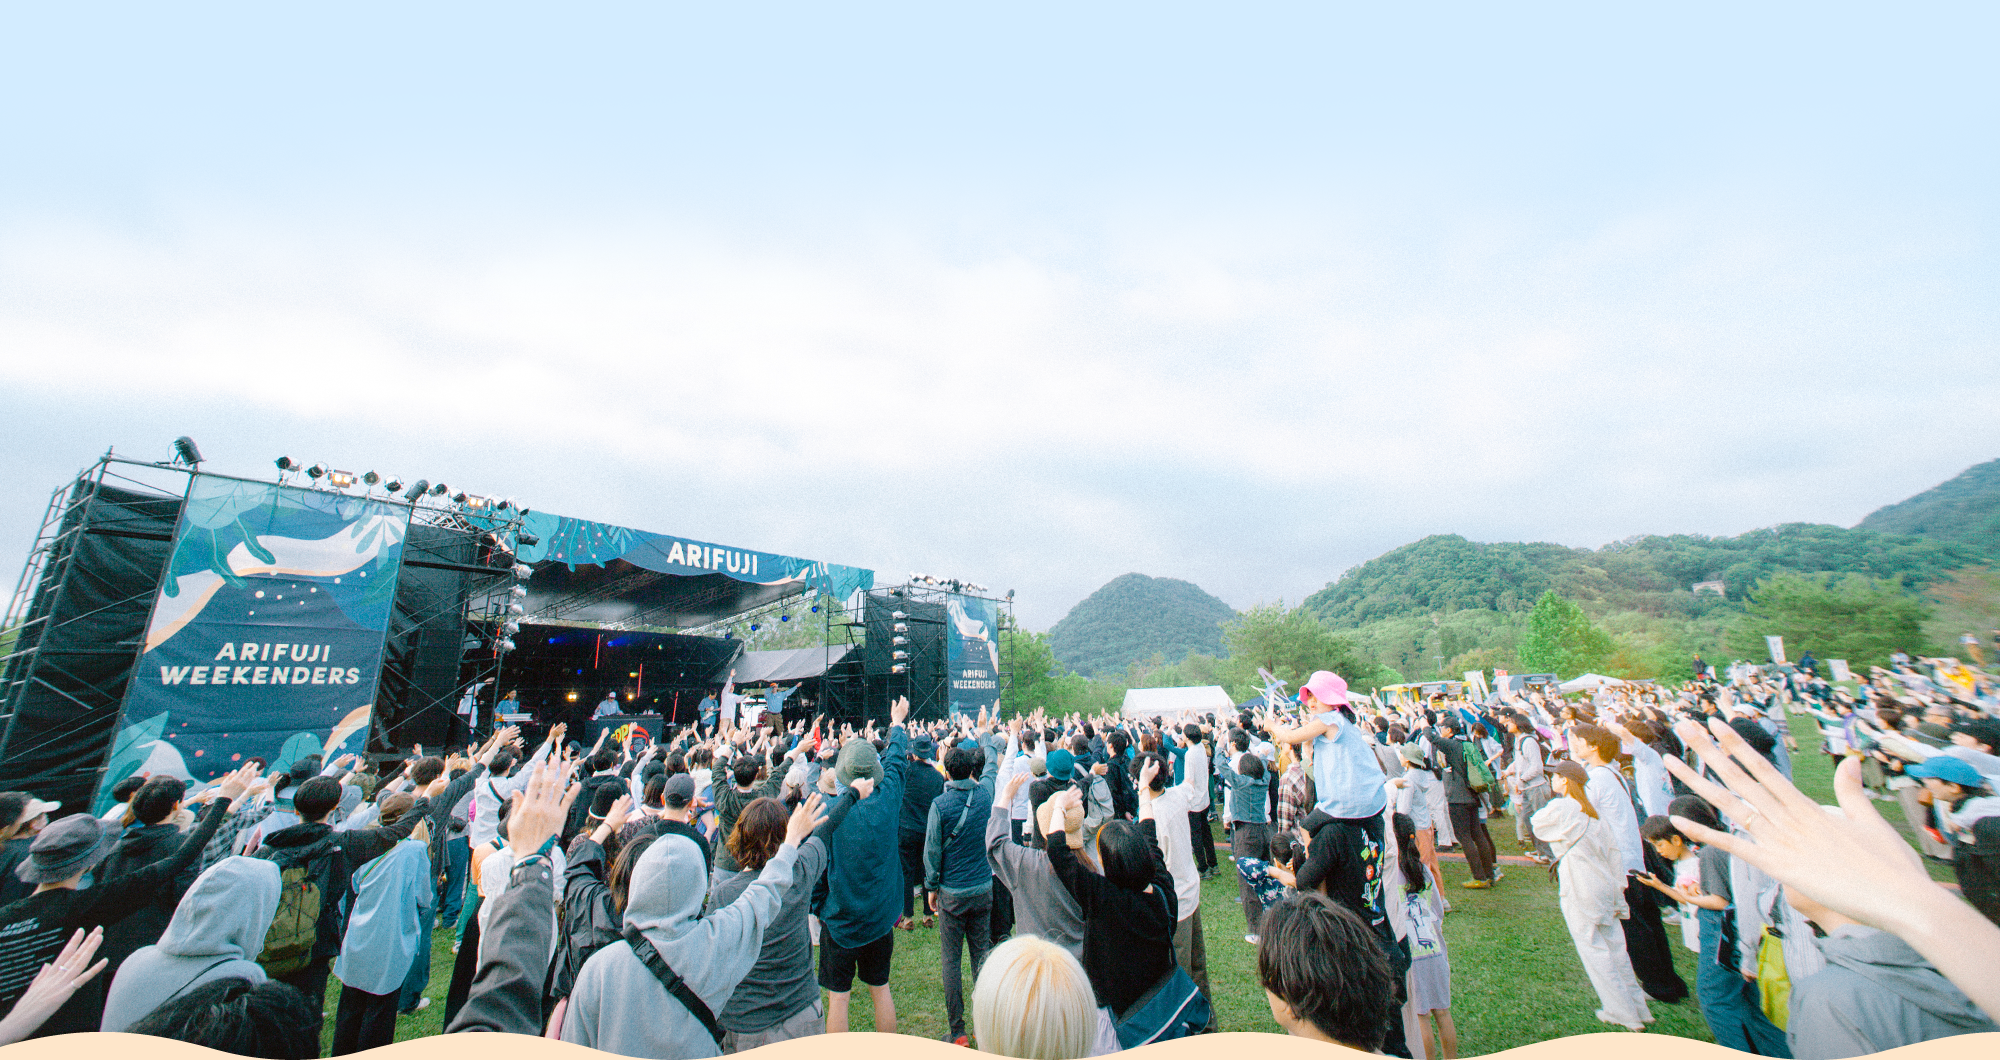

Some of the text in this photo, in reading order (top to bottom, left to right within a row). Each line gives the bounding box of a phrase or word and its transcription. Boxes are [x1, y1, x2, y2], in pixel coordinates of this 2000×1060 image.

[666, 541, 758, 576] ARIFUJI
[214, 642, 331, 662] ARIFUJI
[160, 665, 360, 685] WEEKENDERS
[962, 669, 988, 678] ARIFUJI
[953, 680, 996, 689] WEEKENDERS
